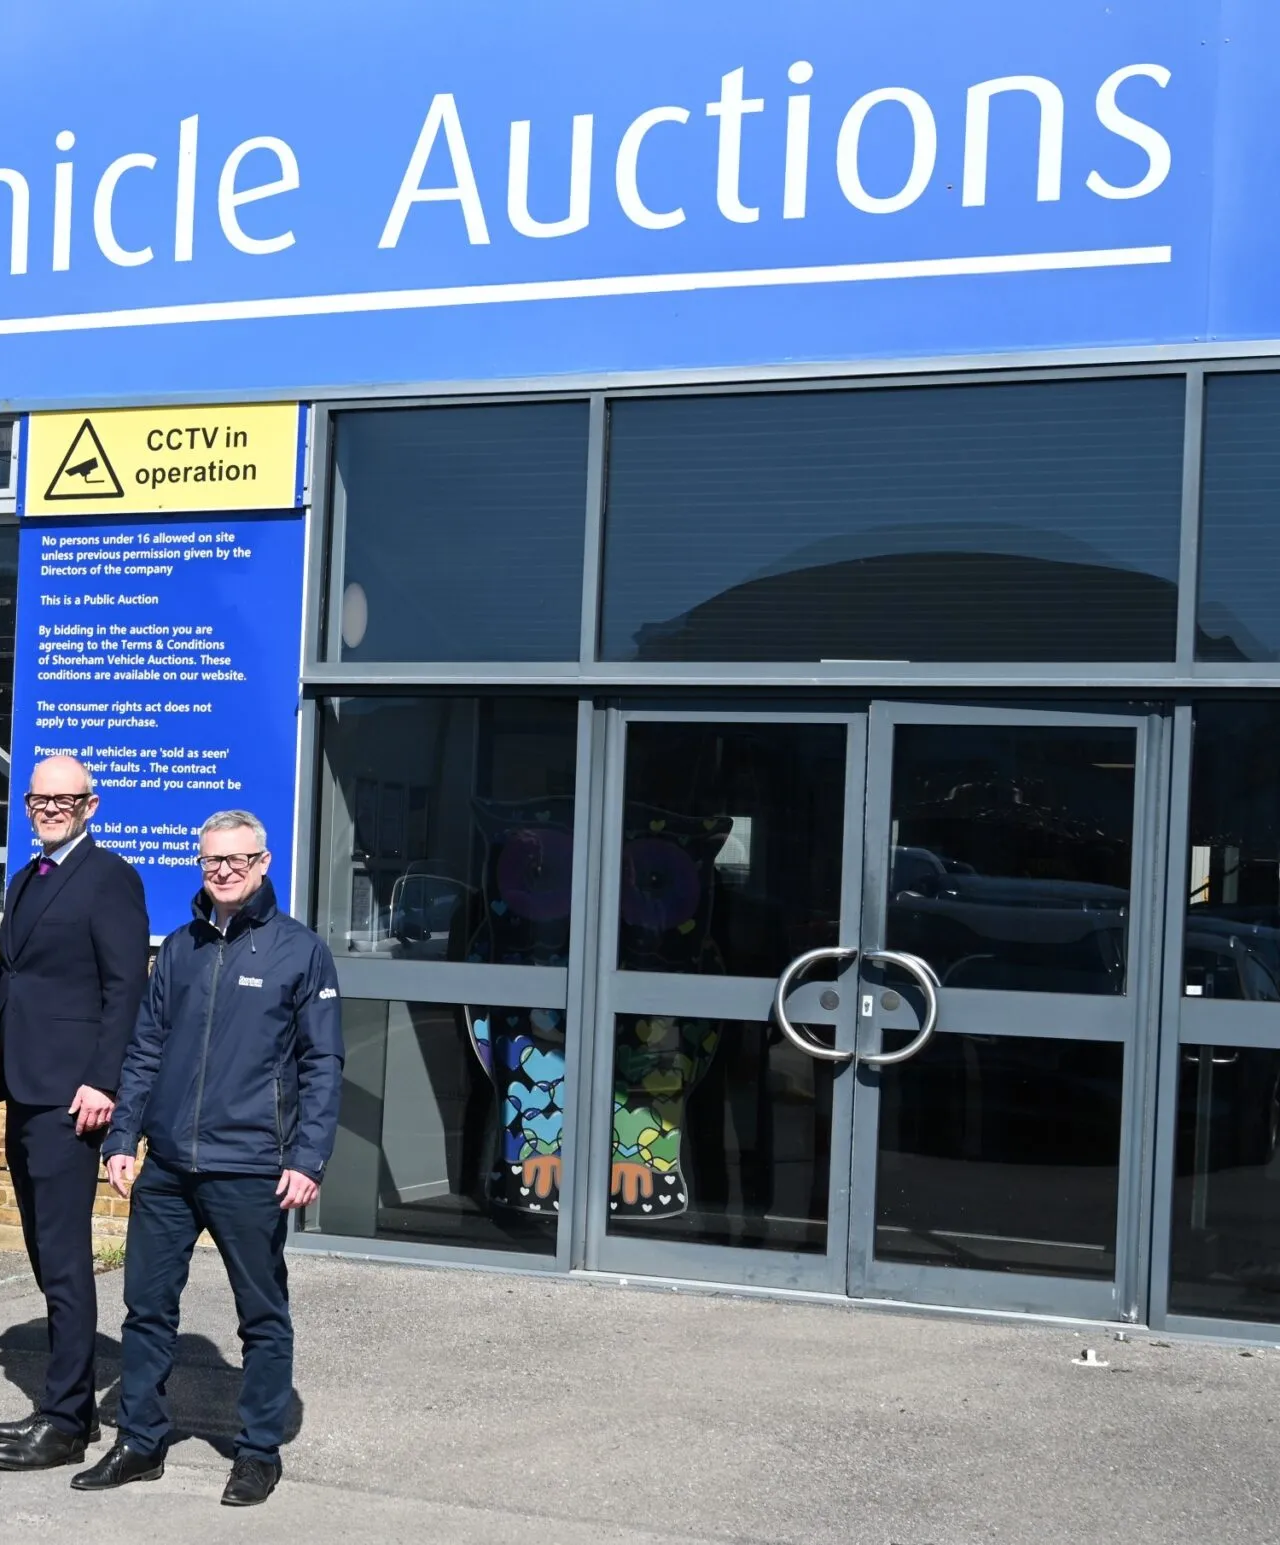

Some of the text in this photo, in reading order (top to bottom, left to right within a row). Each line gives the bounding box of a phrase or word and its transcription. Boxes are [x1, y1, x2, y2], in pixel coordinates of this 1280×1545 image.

[377, 60, 1173, 249] Auctions
[147, 426, 247, 452] CCTV in
[135, 459, 257, 490] operation
[41, 531, 236, 548] No persons under 16 allowed on site
[41, 546, 252, 563] unless previous permission given by the
[40, 563, 174, 577] Directors of the company
[40, 593, 159, 606] This is a Public Auction
[38, 623, 213, 638] By bidding in the auction you are
[38, 638, 225, 653] agreeing to the Terms & Conditions
[38, 654, 232, 666] of Shoreham Vehicle Auctions. These
[37, 669, 247, 681] conditions are available on our website.
[36, 700, 212, 715] The consumer rights act does not
[35, 715, 159, 729] apply to your purchase.
[34, 745, 230, 759] Presume all vehicles are 'sold as seen'
[109, 761, 141, 773] faults
[149, 762, 169, 774] The
[171, 763, 217, 774] contract
[100, 776, 138, 788] vendor
[140, 777, 161, 788] and
[163, 780, 184, 791] you
[186, 779, 225, 790] cannot
[227, 778, 242, 790] be
[89, 822, 102, 833] to
[104, 822, 122, 834] bid
[124, 825, 139, 834] on
[140, 825, 148, 834] a
[150, 823, 188, 836] vehicle
[94, 839, 137, 849] account
[139, 840, 160, 852] you
[162, 840, 190, 851] must
[147, 856, 155, 865] a
[157, 854, 199, 868] deposit
